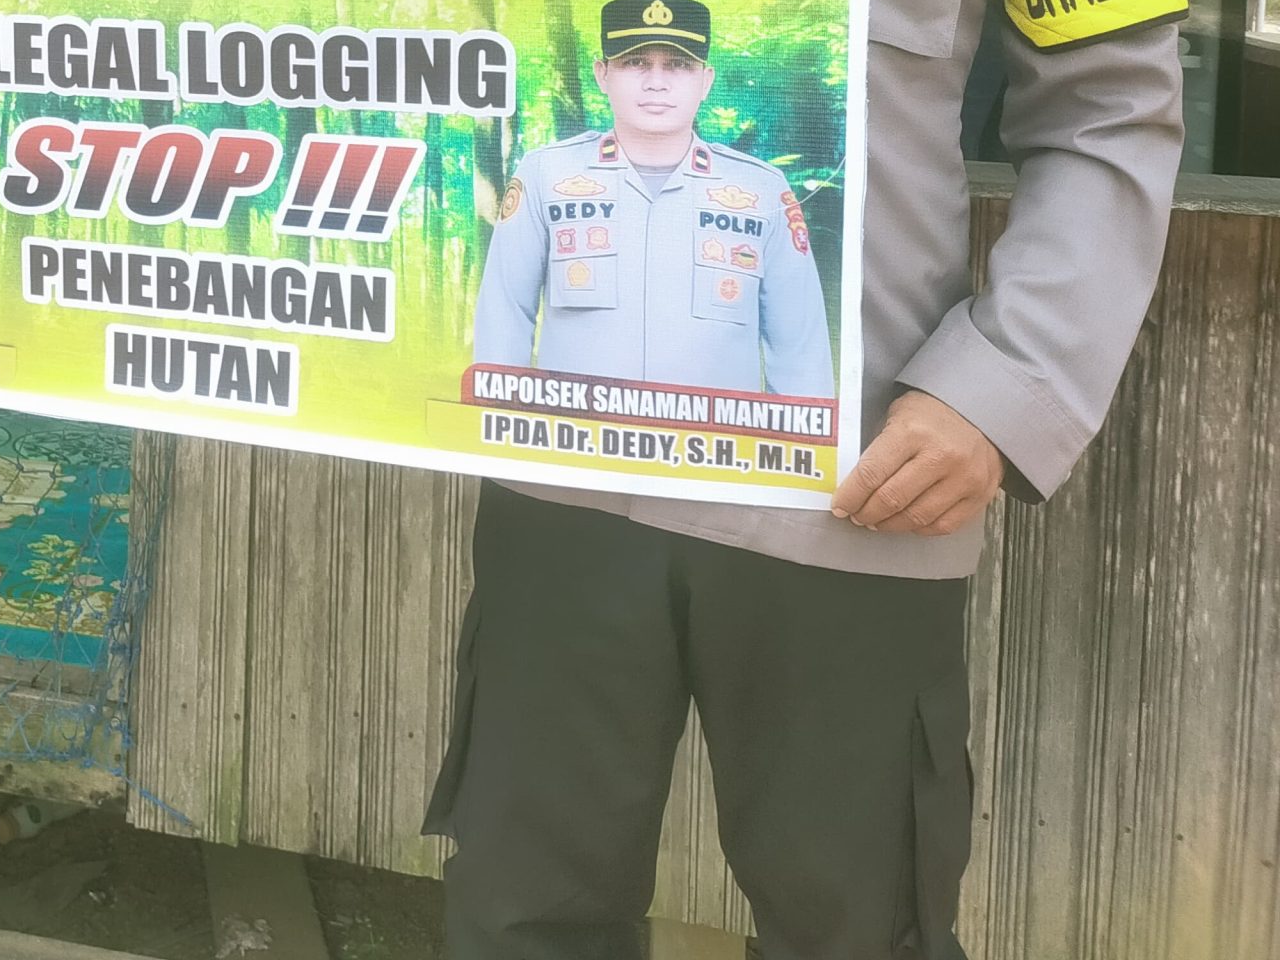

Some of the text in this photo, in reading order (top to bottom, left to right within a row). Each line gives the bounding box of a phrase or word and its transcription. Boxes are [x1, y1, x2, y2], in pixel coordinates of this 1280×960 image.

[187, 30, 508, 110] LOGGING
[3, 124, 420, 234] STOP !!!
[548, 201, 615, 222] DEDY
[700, 211, 764, 238] POLRI
[29, 245, 387, 333] PENEBANGAN
[113, 332, 291, 407] HUTAN
[474, 371, 831, 436] KAPOLSEK SANAMAN MANTIKEI
[484, 414, 821, 478] IPDA Dr. DEDY, S.H., M.H.
